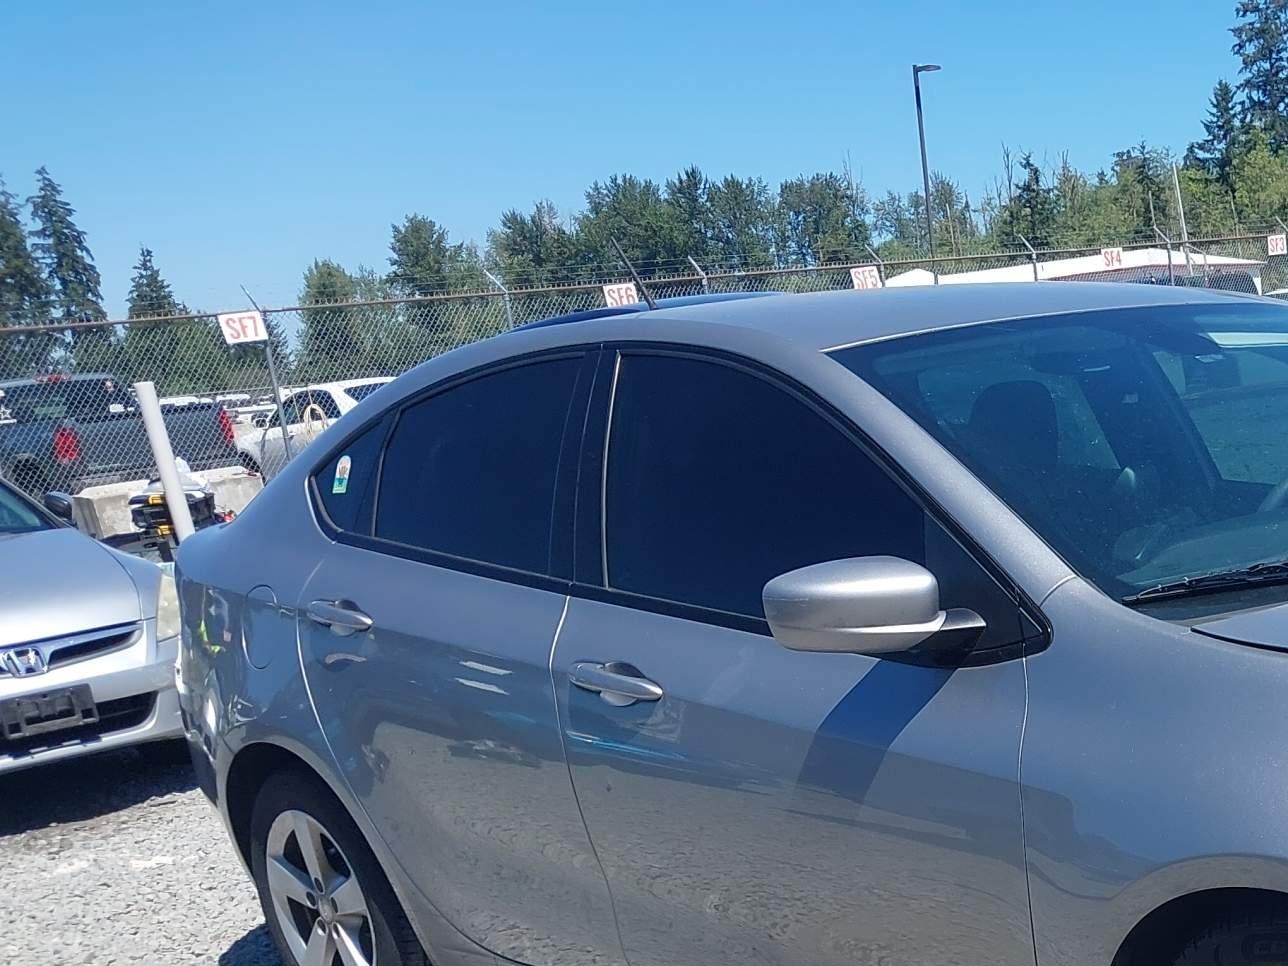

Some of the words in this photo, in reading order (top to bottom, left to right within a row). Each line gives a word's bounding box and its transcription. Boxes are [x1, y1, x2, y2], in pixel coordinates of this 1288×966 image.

[1270, 236, 1285, 252] SF3
[1104, 249, 1122, 266] SF4
[854, 269, 878, 289] SF5
[607, 286, 637, 306] SF6
[225, 316, 259, 339] SF7
